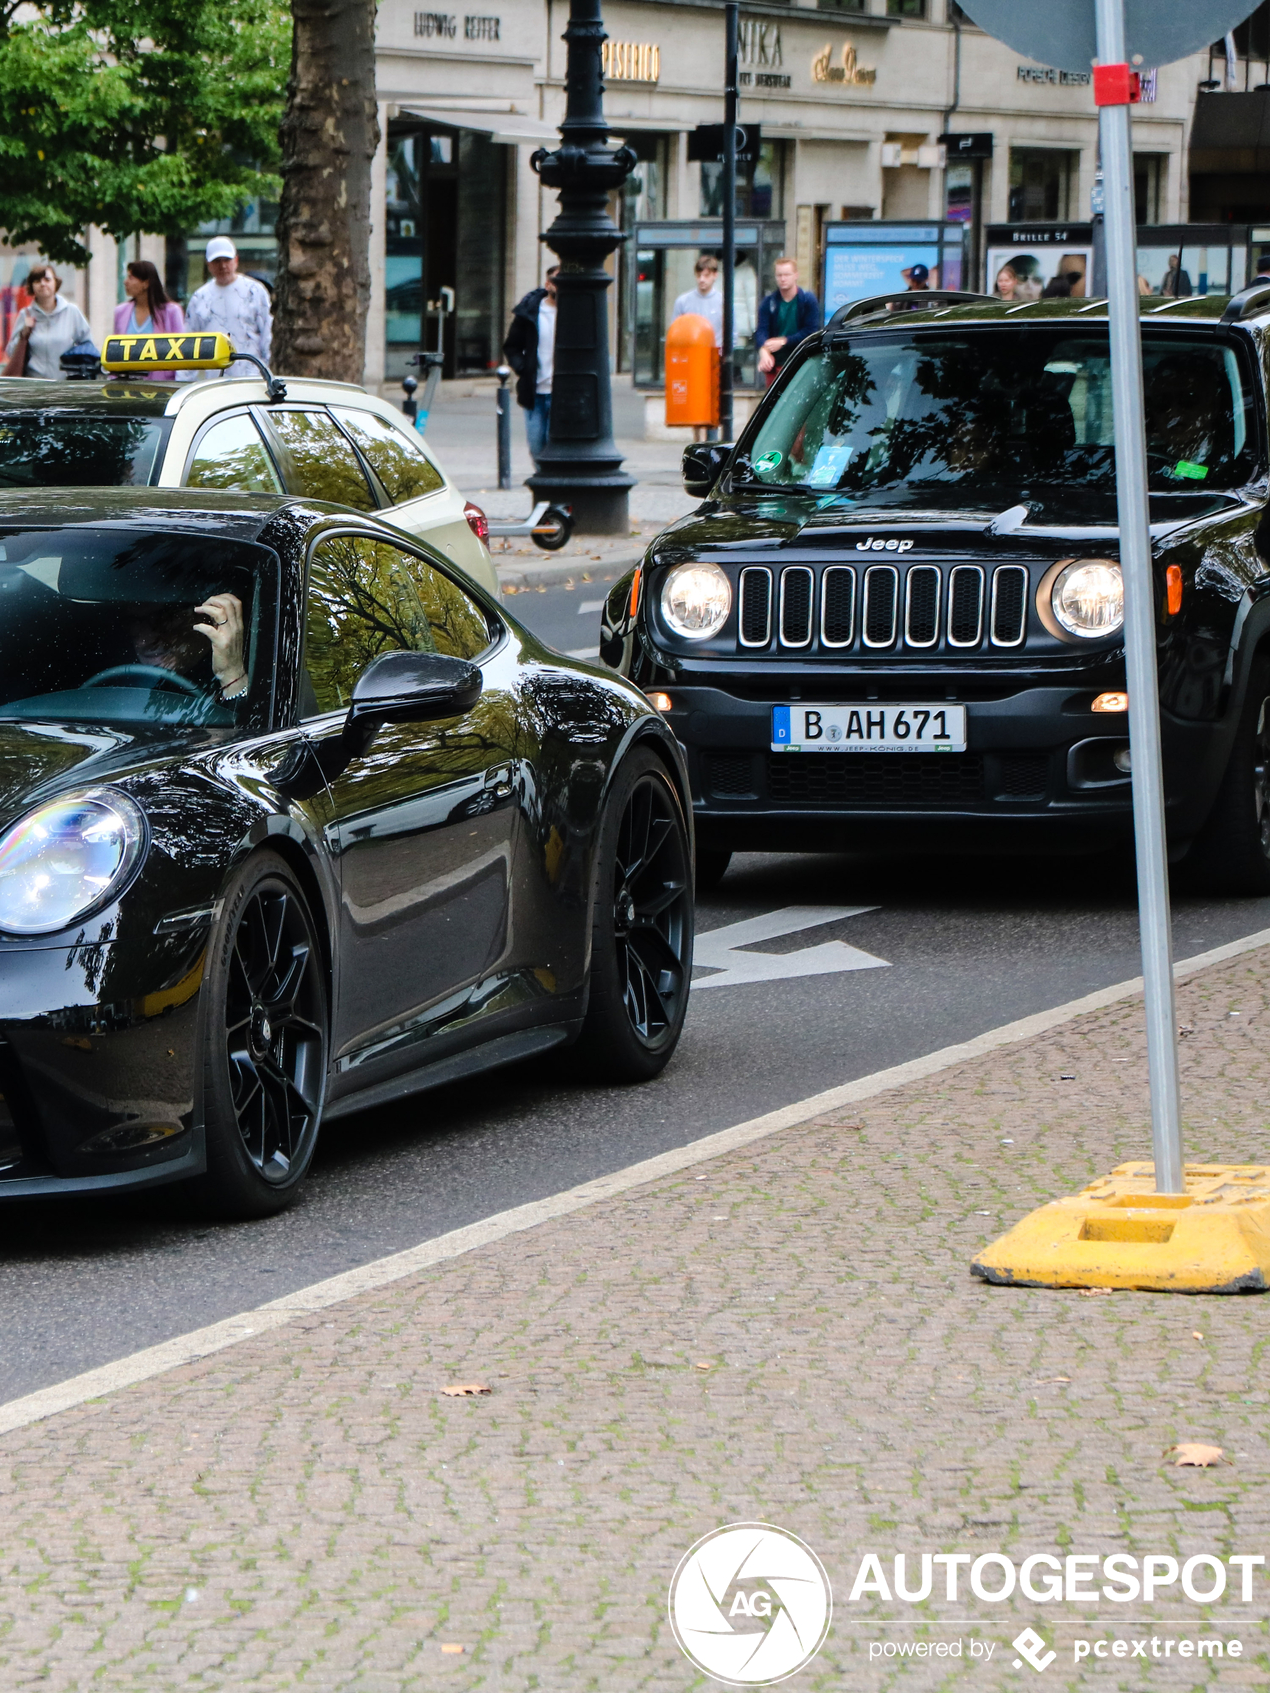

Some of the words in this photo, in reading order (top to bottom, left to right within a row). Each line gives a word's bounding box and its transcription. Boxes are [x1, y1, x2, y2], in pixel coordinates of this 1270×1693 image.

[414, 12, 457, 39] LUDWIG
[464, 15, 500, 41] REITER
[602, 42, 659, 81] PESERICO
[1055, 231, 1069, 241] 54
[119, 338, 201, 361] TAXI
[855, 537, 914, 554] Jeep
[779, 729, 786, 738] D
[805, 711, 823, 739] B
